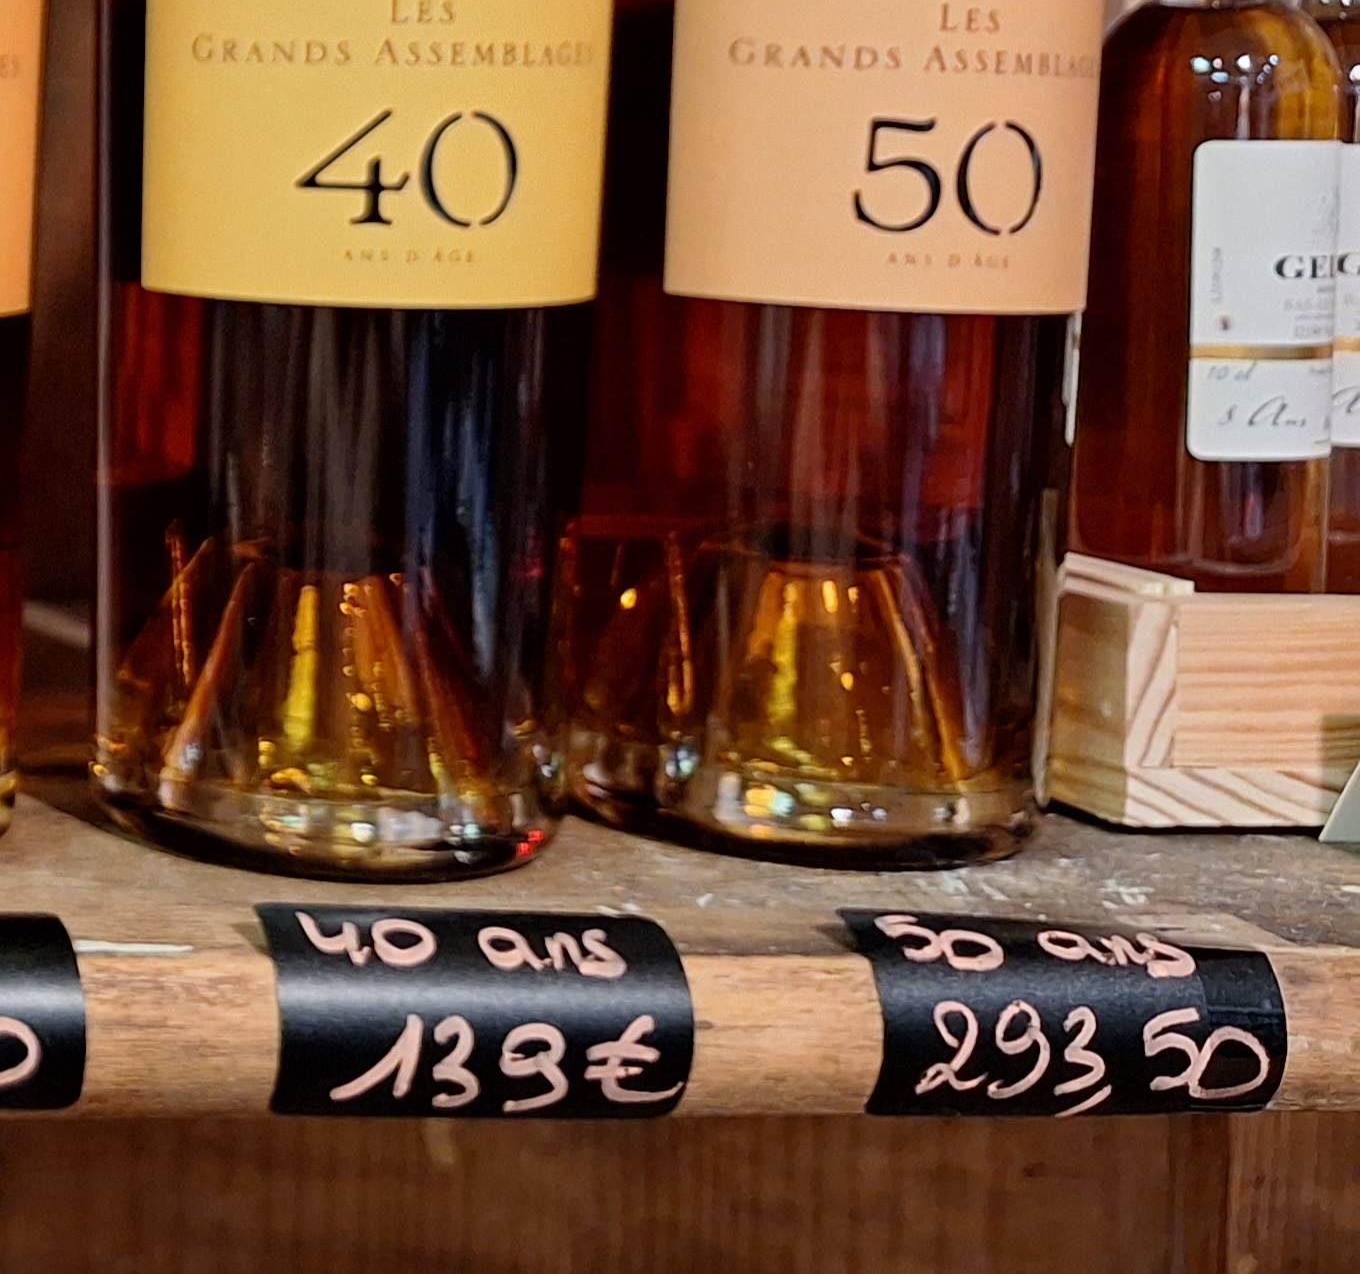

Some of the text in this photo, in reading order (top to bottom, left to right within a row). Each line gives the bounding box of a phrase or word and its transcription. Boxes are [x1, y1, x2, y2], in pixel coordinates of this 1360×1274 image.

[191, 33, 352, 65] GRANDS
[939, 3, 1000, 32] LES
[728, 38, 1096, 79] GRANDS ASSEMBLAG
[294, 109, 519, 228] 40
[854, 117, 1042, 236] 50
[295, 912, 627, 978] 40 ans
[875, 915, 1196, 977] 50 ans
[330, 1014, 685, 1113] 139€
